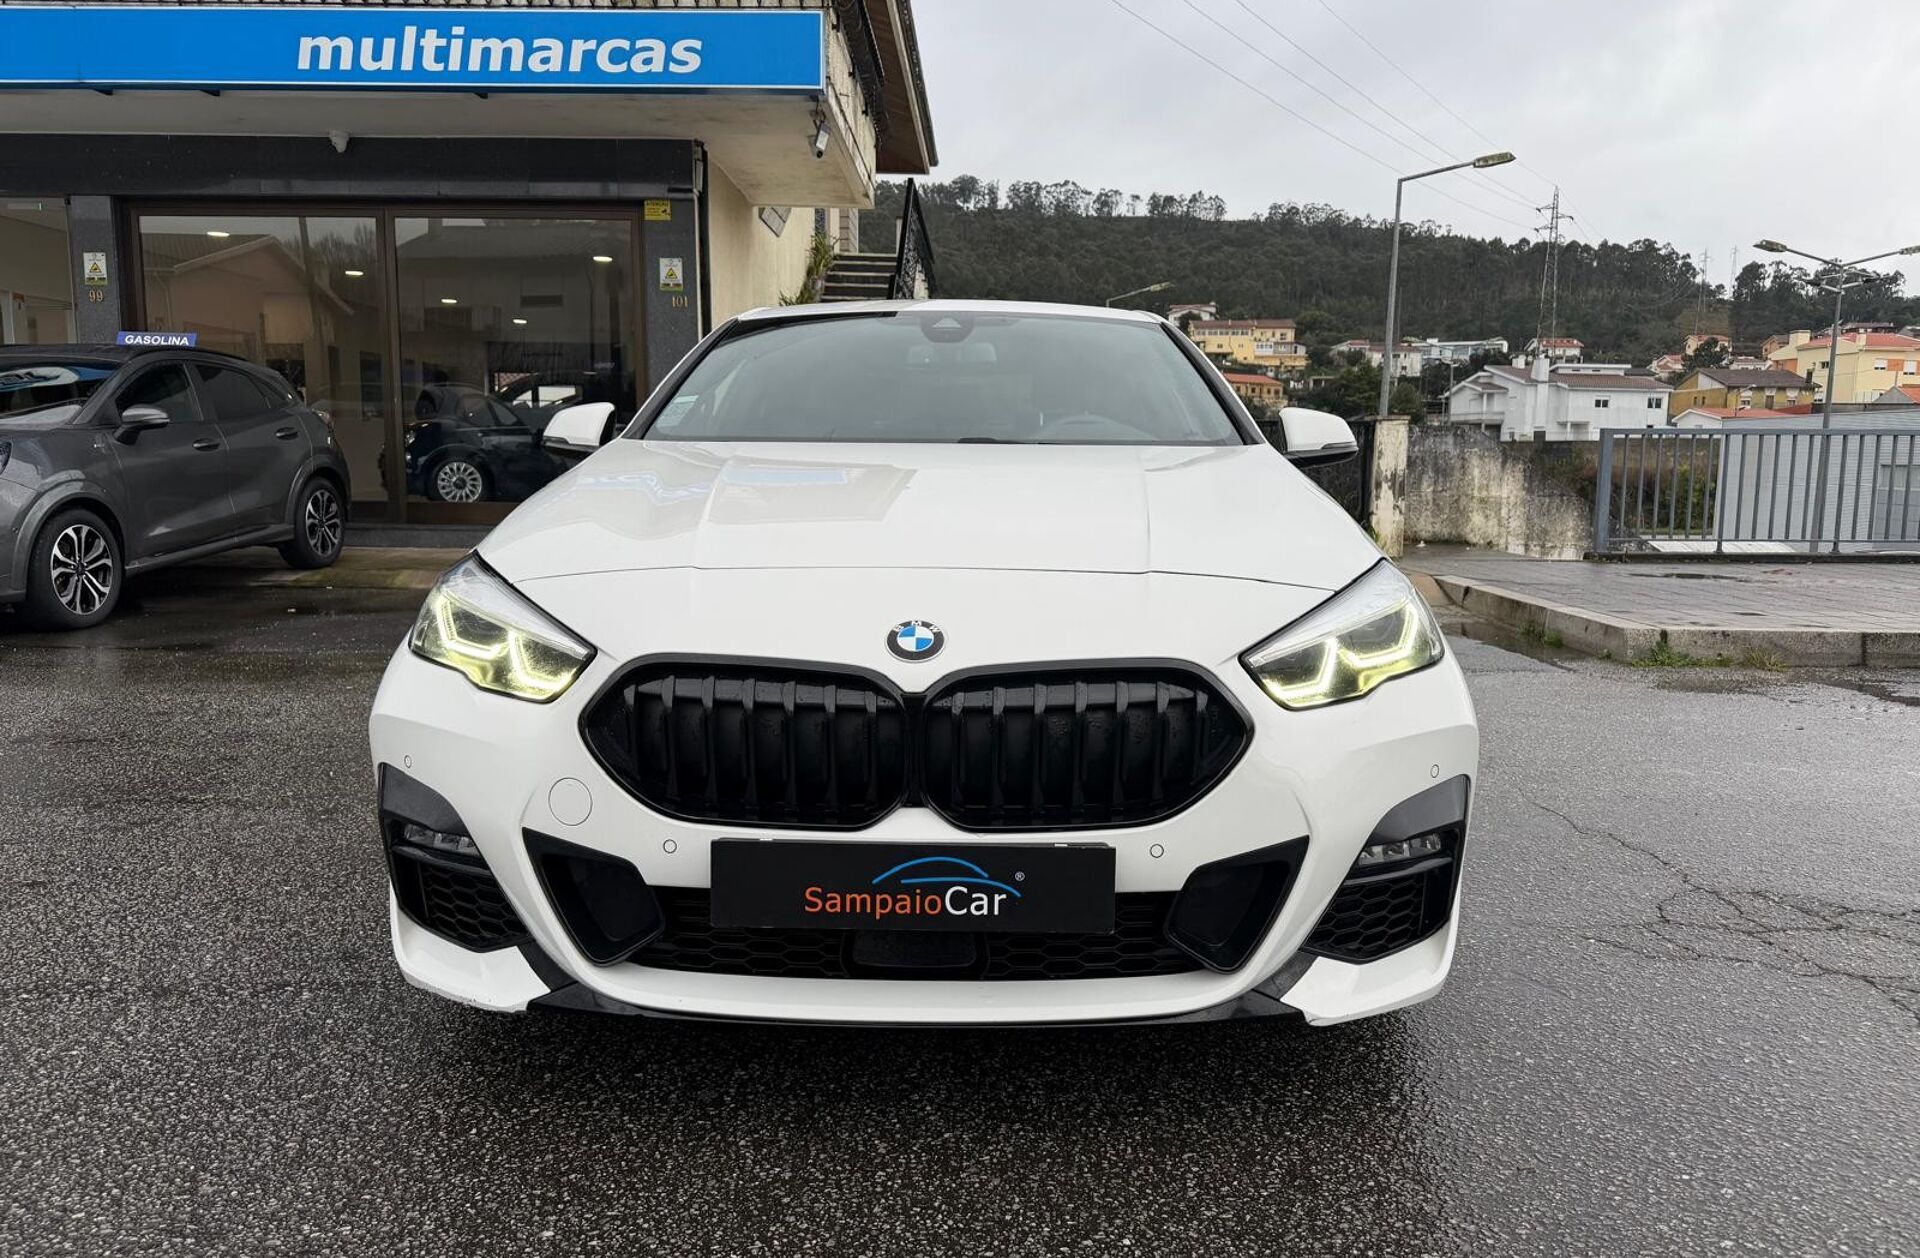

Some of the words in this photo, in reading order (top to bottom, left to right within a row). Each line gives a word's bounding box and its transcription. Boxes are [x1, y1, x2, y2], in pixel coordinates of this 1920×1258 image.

[298, 25, 702, 74] multimarcas
[89, 290, 103, 302] 99
[672, 296, 688, 308] 101
[125, 335, 189, 346] GASOLINA
[804, 886, 1007, 920] SampaioCar
